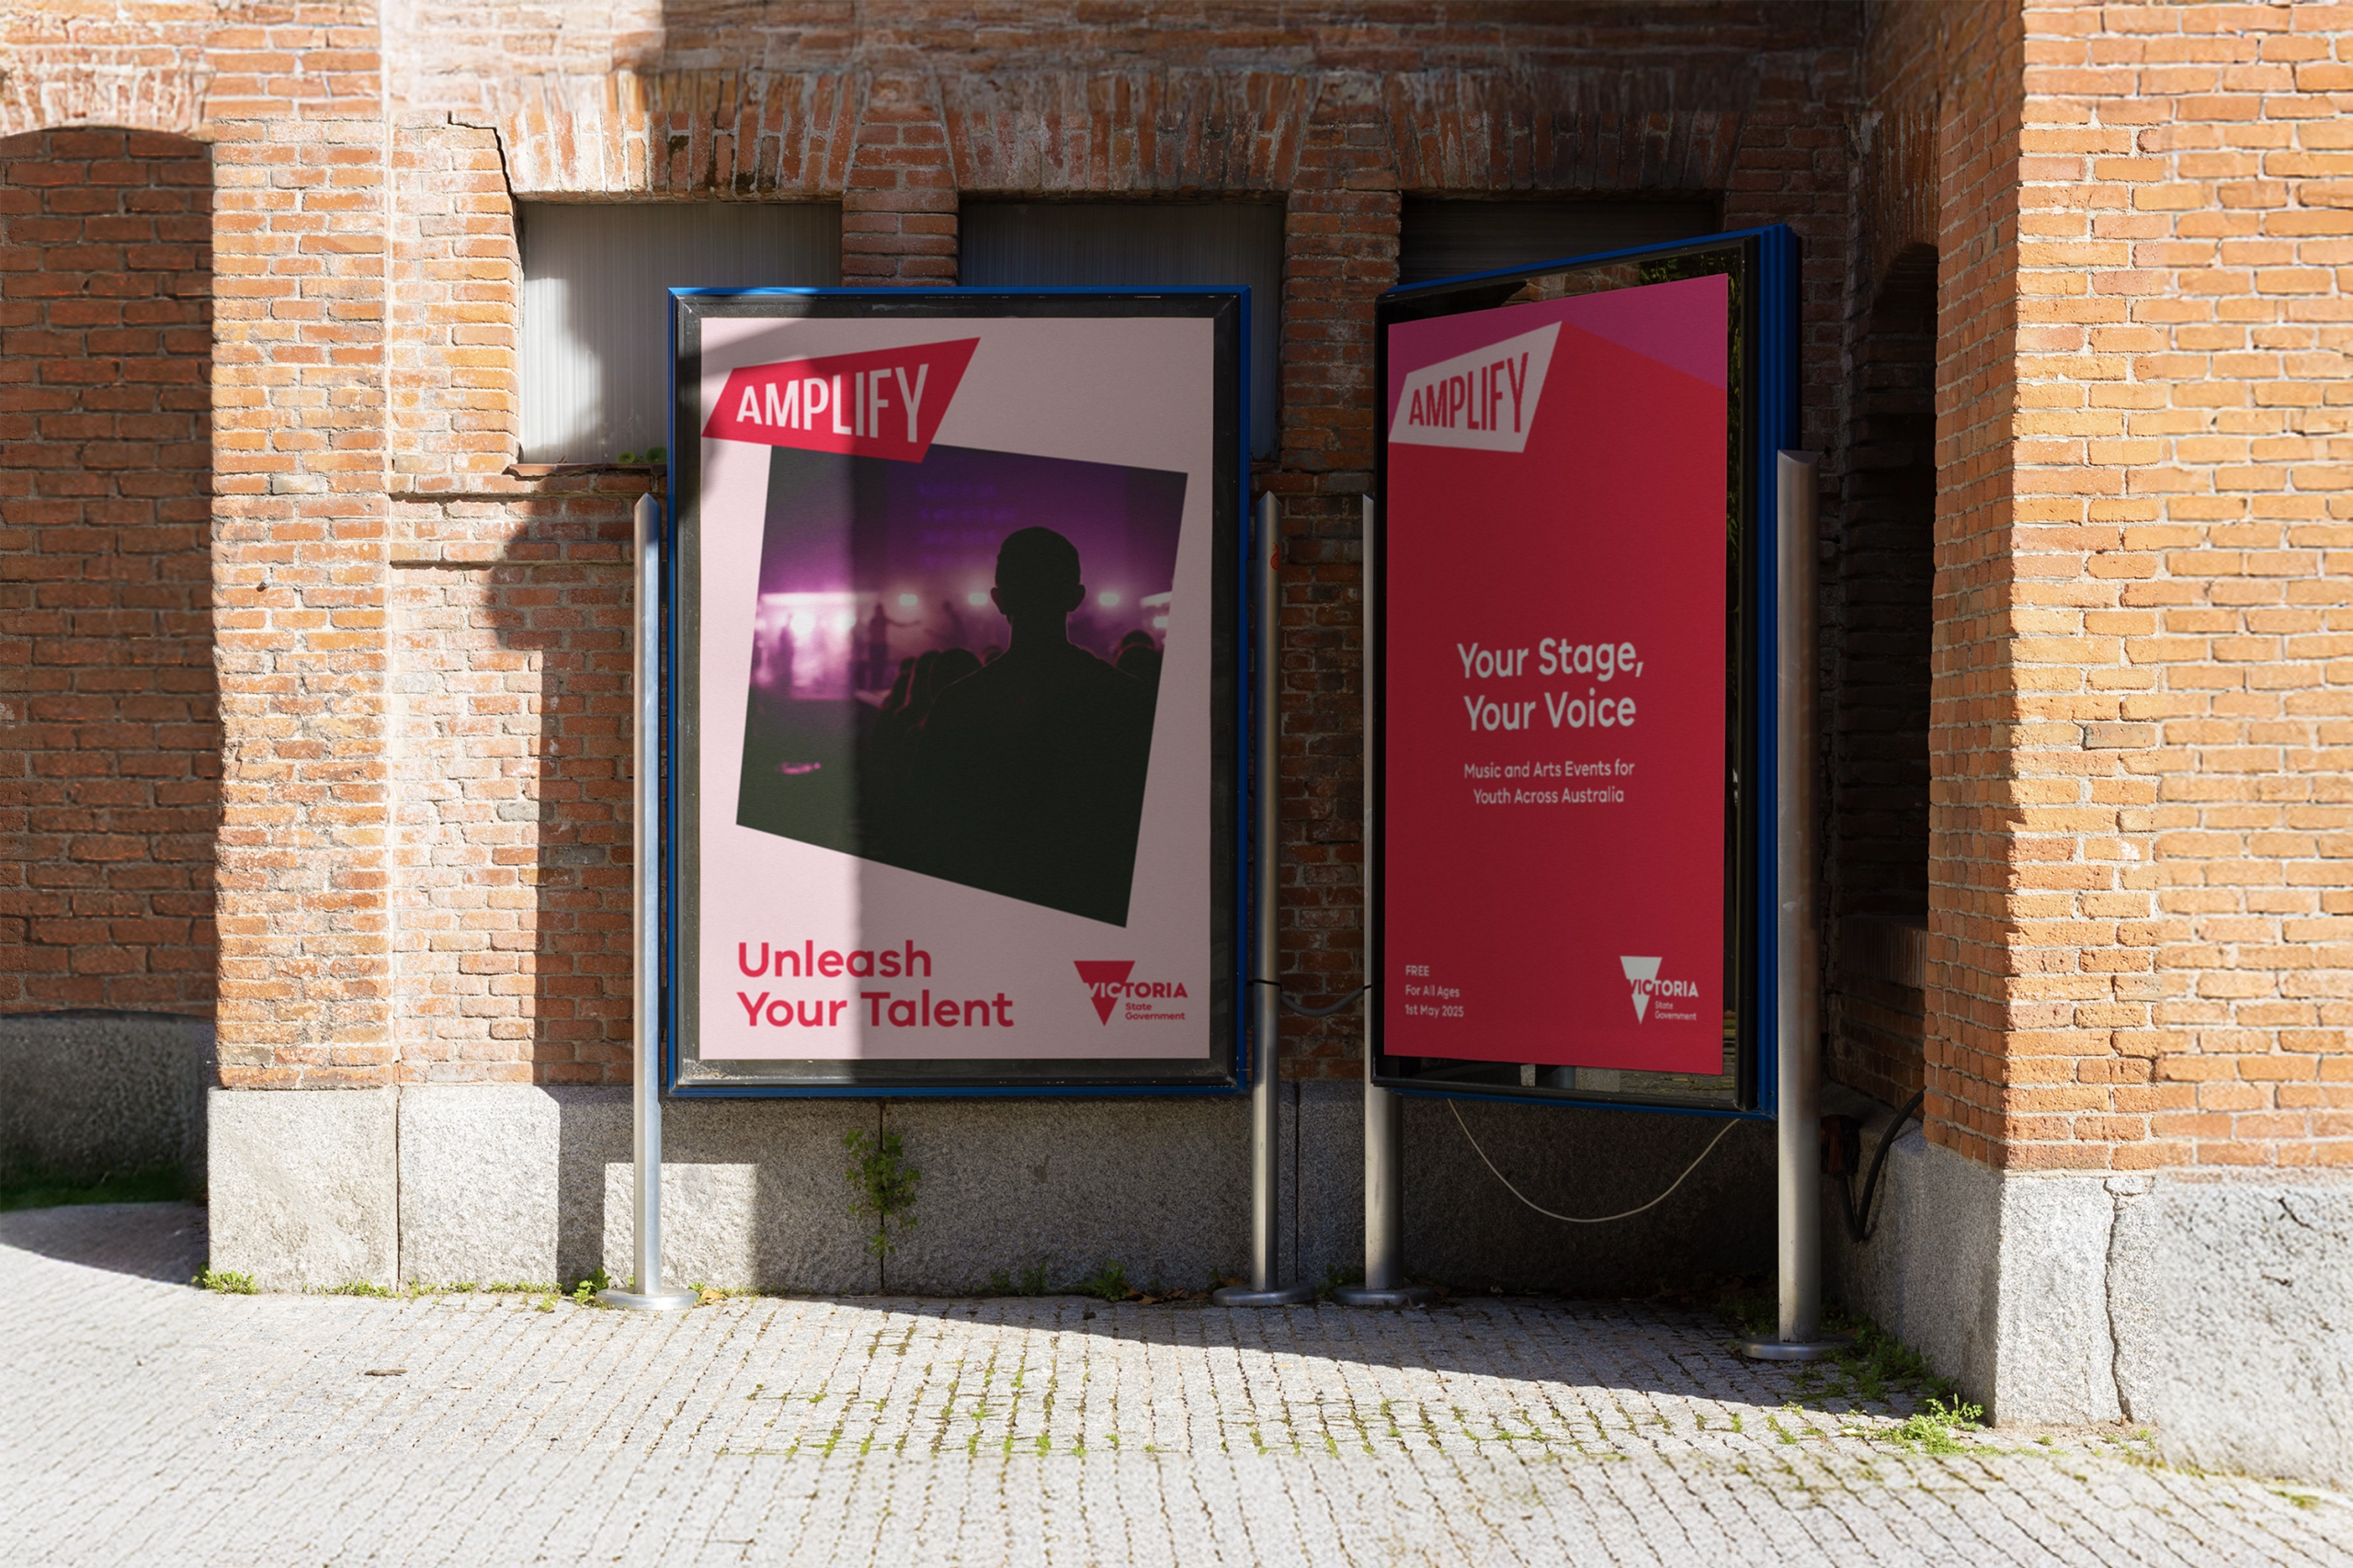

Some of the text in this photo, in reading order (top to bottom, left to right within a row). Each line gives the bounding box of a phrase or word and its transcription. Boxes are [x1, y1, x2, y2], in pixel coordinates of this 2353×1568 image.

[1408, 352, 1529, 433] AMPLIFY
[735, 363, 929, 443] AMPLIFY
[1457, 638, 1643, 682] Your Stage,
[1463, 687, 1636, 731] Your Voice
[1464, 758, 1635, 778] Music and Arts Events for
[1473, 786, 1624, 804] Youth Across Australia
[738, 939, 932, 978] Unleash
[1405, 964, 1430, 977] FREE
[1085, 982, 1188, 999] VICTORIA
[1405, 984, 1460, 1000] For All Ages
[1628, 978, 1699, 997] VICTORIA
[736, 989, 1015, 1028] Your Talent
[1125, 1002, 1153, 1011] State
[1404, 1004, 1464, 1018] 1st May 2025
[1654, 1001, 1674, 1010] State
[1124, 1011, 1186, 1020] Government
[1654, 1011, 1697, 1021] Government
